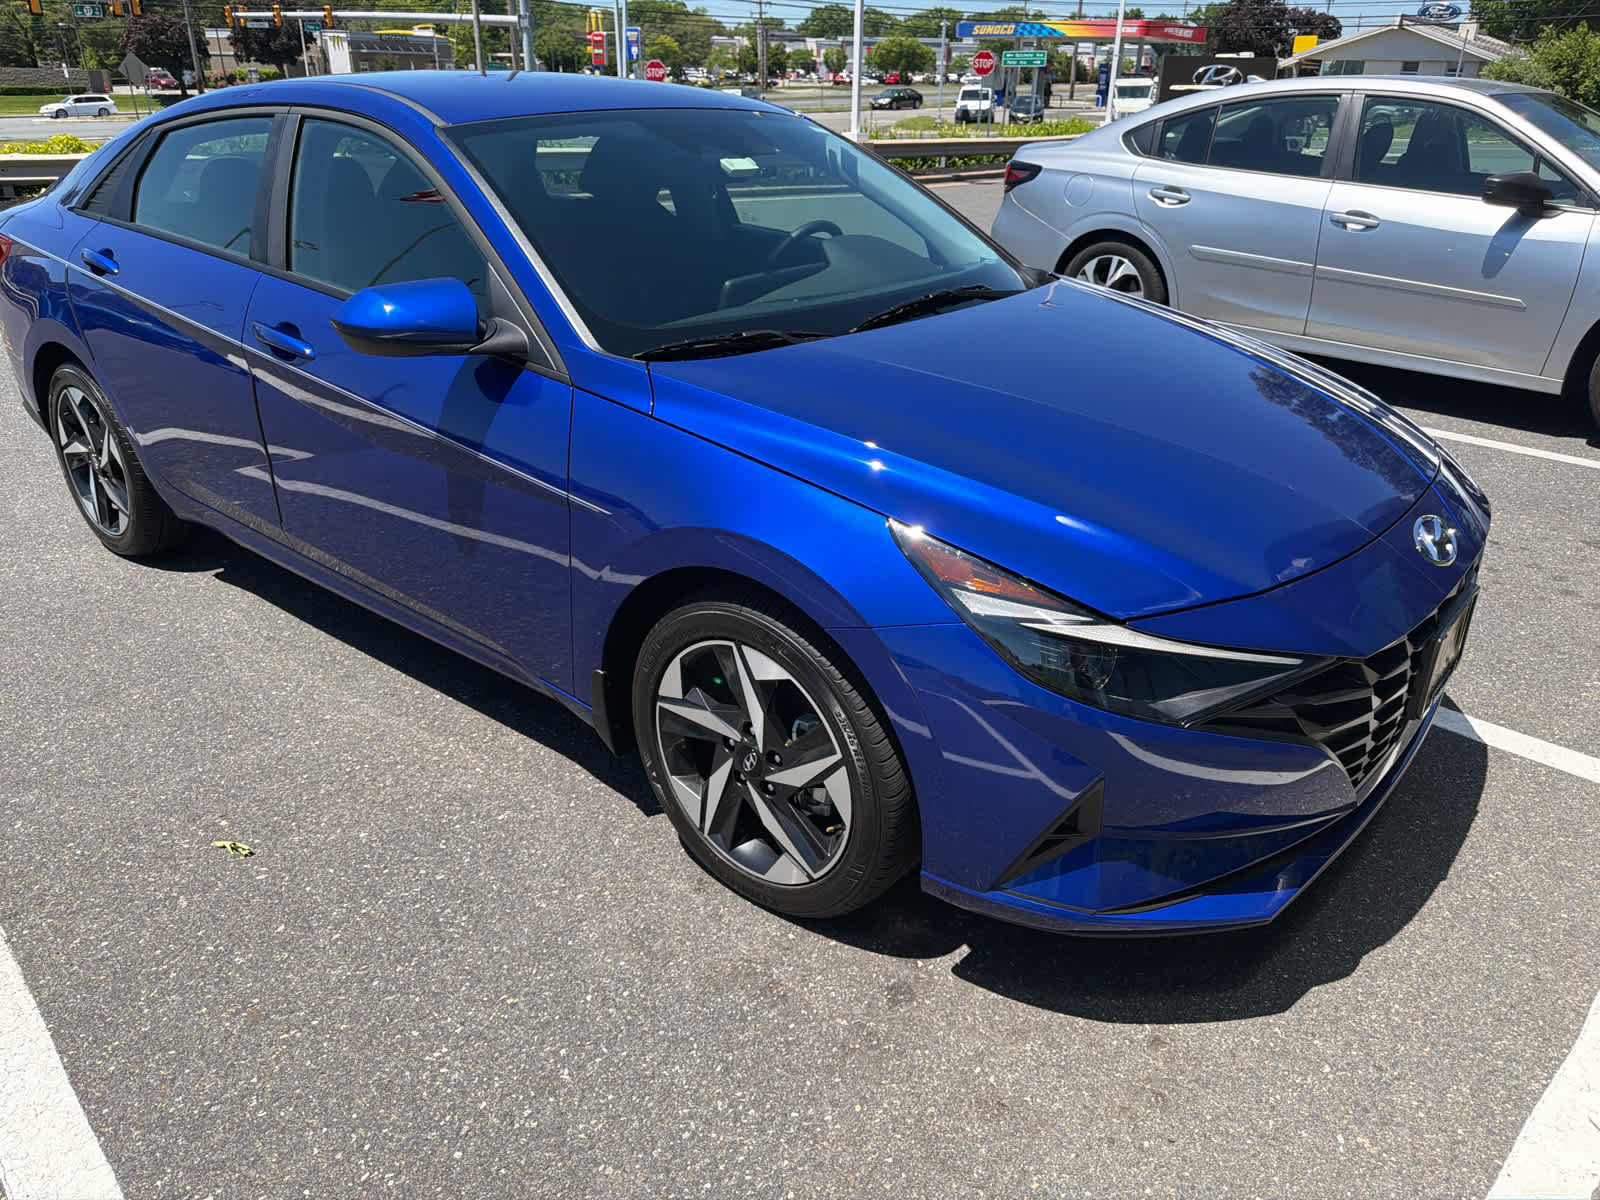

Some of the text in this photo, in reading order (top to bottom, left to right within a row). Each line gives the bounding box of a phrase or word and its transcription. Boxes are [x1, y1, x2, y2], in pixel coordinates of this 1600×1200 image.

[972, 24, 1015, 34] SUNOCO
[973, 58, 993, 68] STOP
[646, 67, 665, 77] STOP
